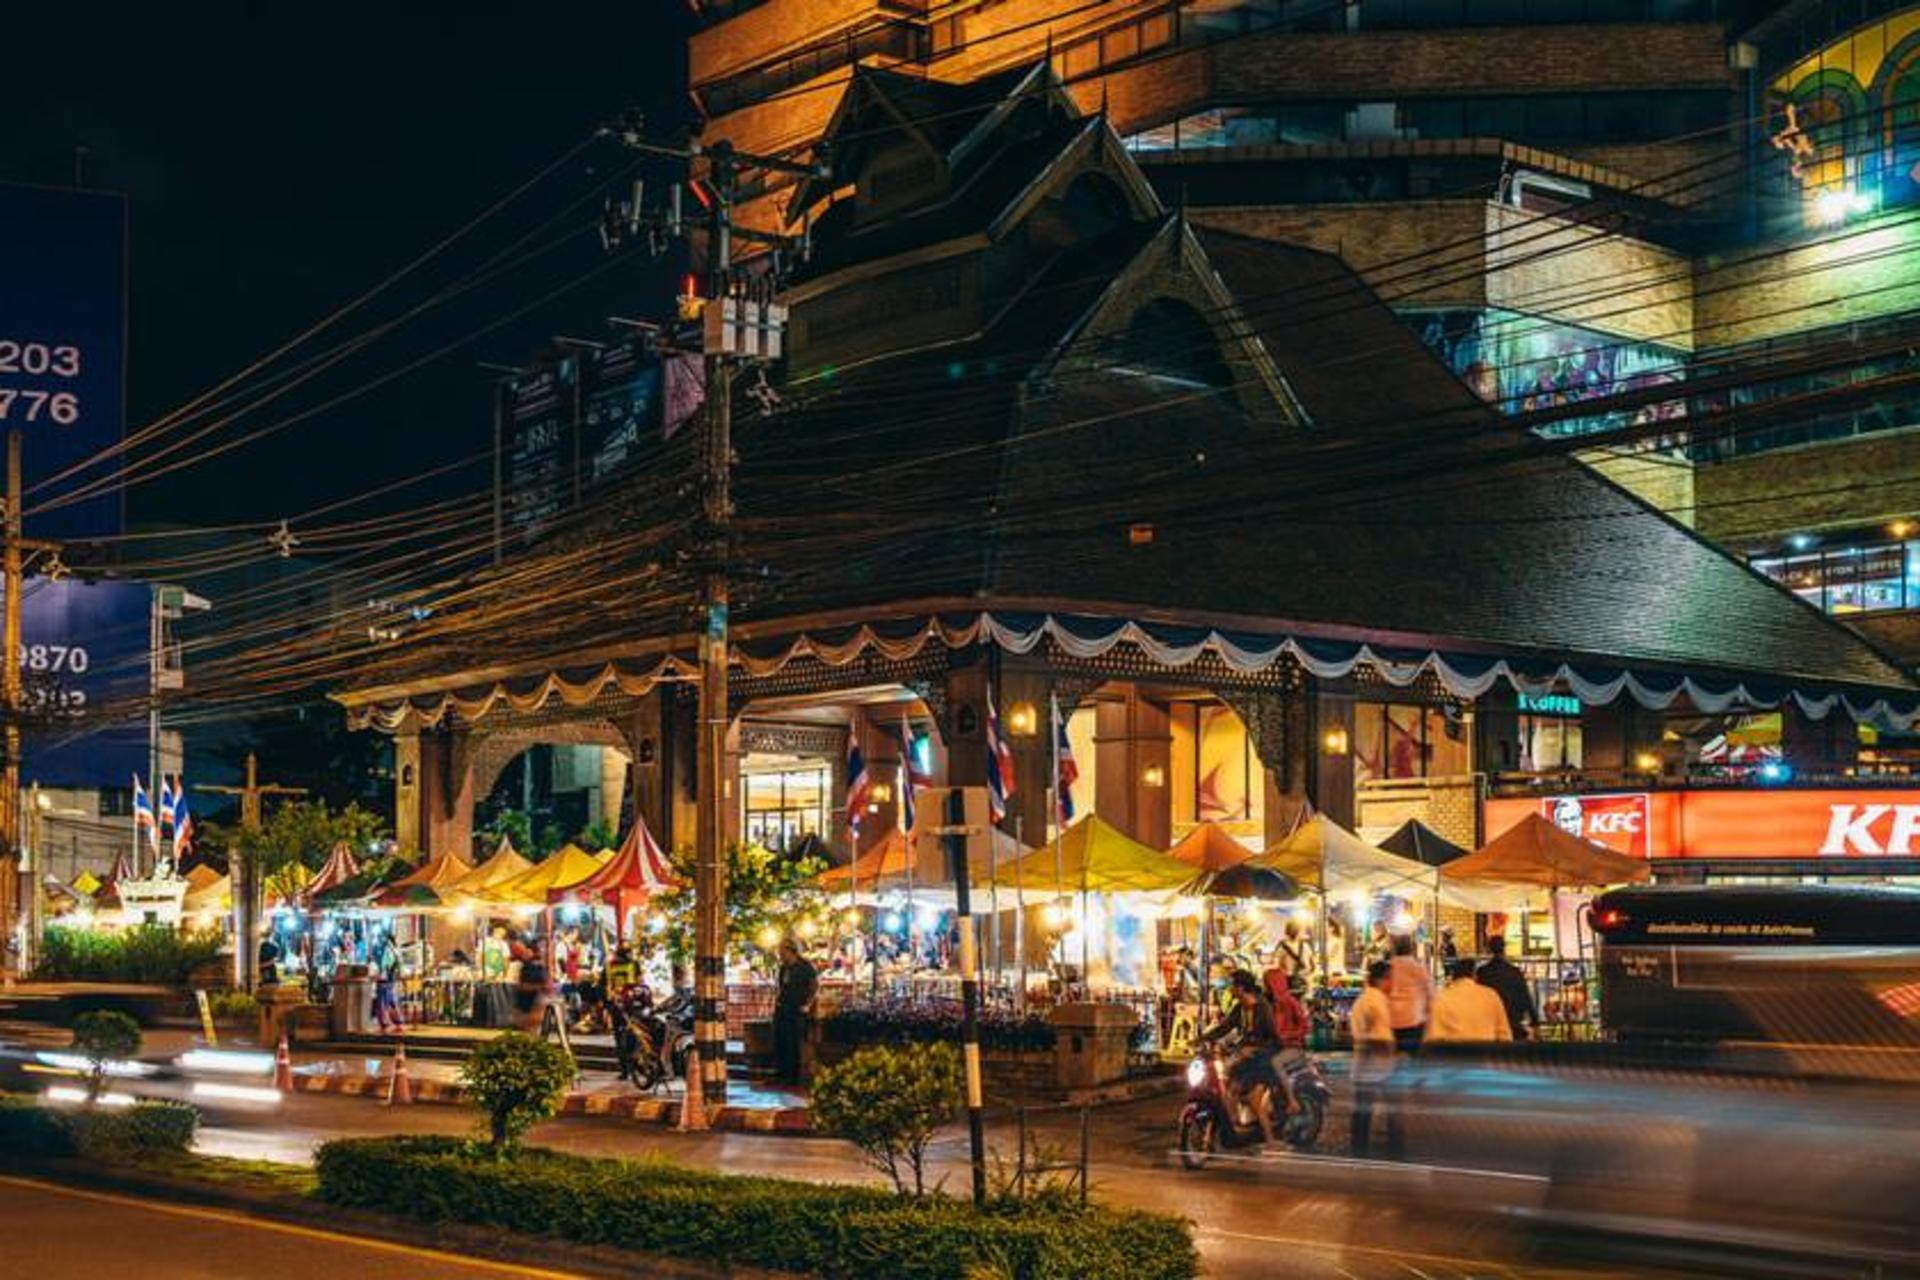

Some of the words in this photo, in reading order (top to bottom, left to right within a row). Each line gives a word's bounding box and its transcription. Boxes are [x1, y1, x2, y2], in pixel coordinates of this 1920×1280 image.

[0, 341, 79, 377] 203
[0, 389, 79, 424] 776
[1529, 695, 1580, 714] COFFEE
[1588, 811, 1643, 833] KFC
[1818, 804, 1920, 857] KF
